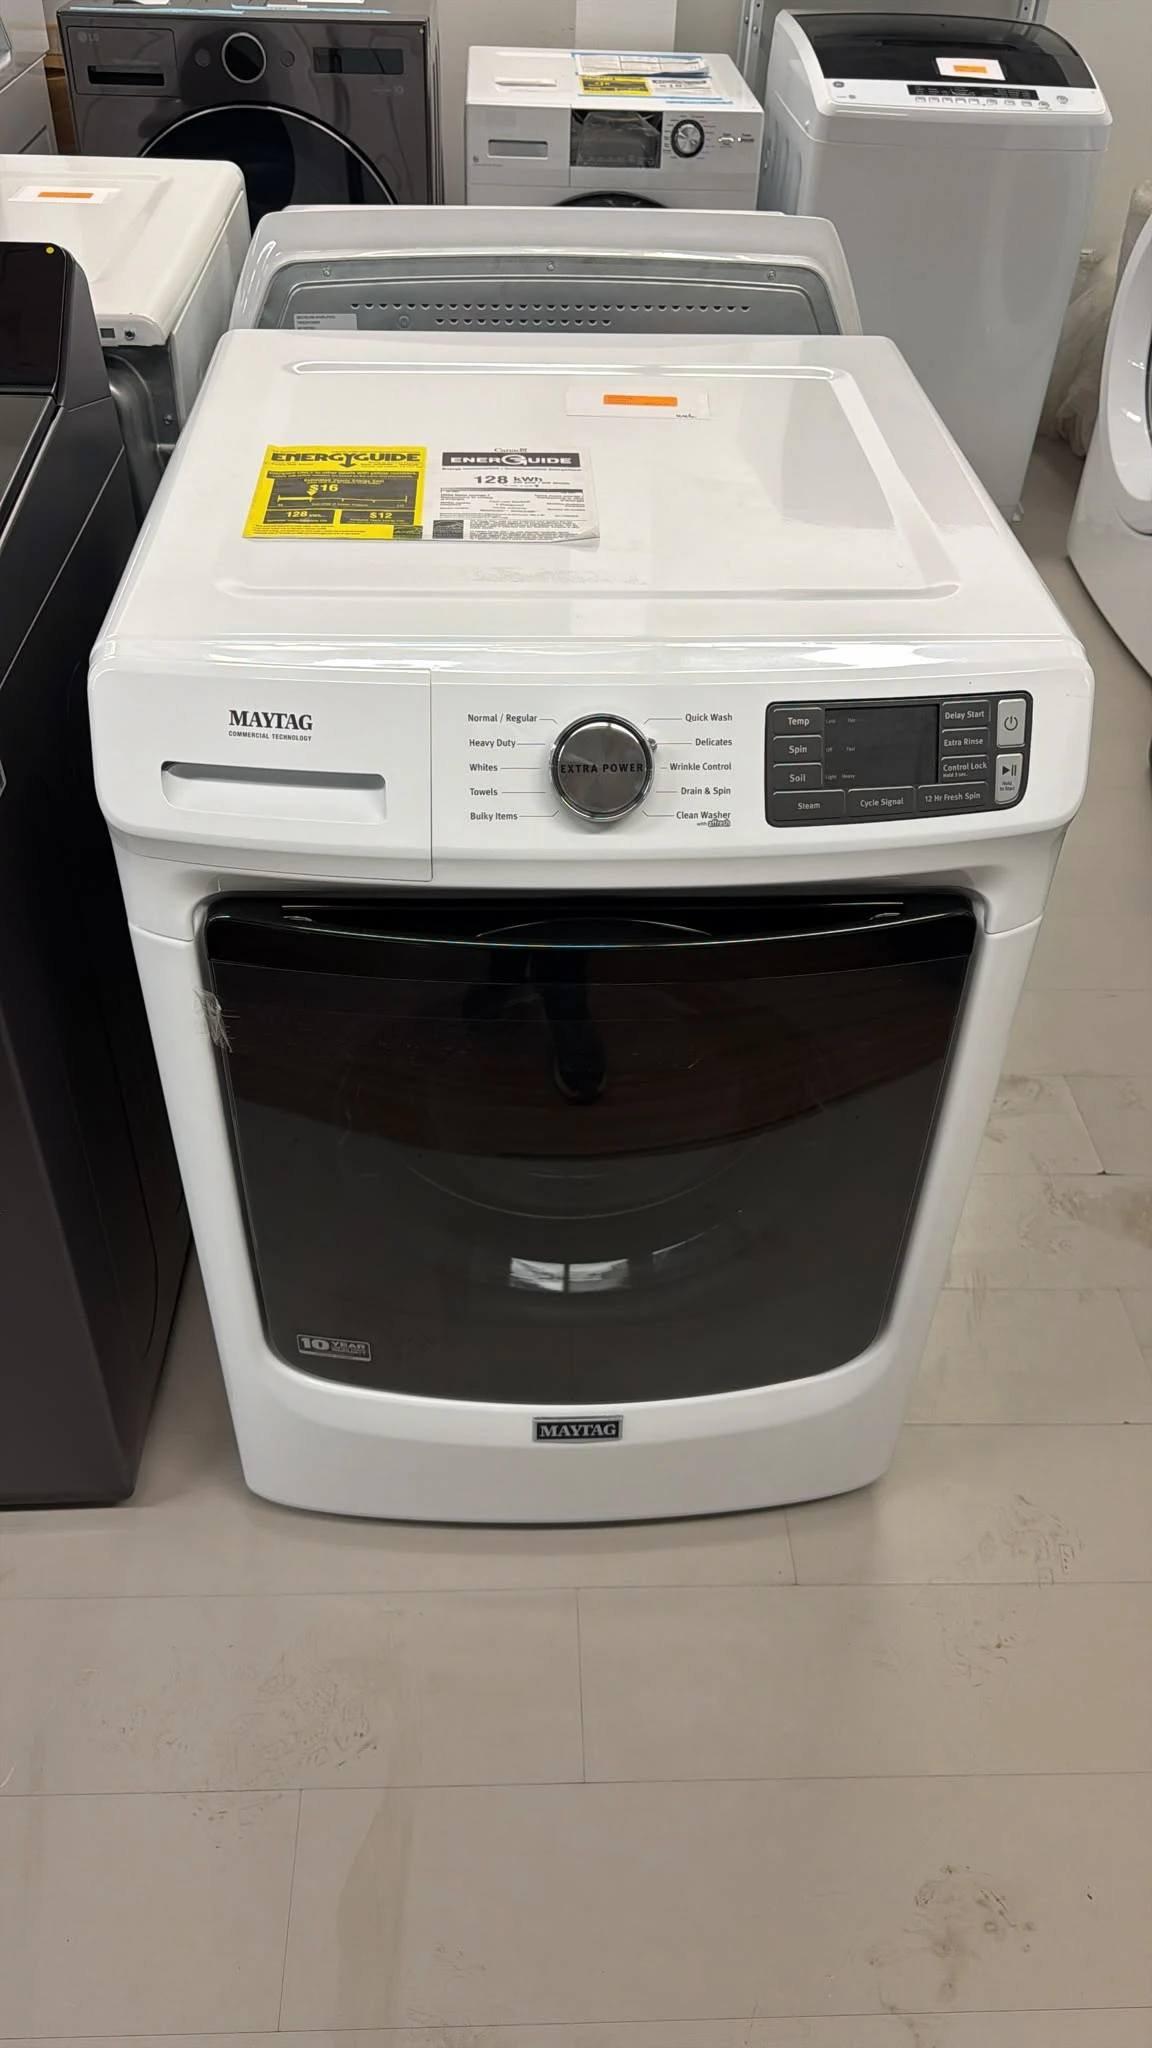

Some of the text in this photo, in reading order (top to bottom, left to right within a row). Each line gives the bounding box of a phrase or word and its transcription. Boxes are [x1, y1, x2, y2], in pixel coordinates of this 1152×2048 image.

[271, 452, 421, 464] ENERGYGUIDE
[450, 454, 572, 466] ENERGUIDE
[474, 475, 543, 484] 128 kWh
[308, 483, 339, 493] $16
[286, 510, 308, 518] 128
[369, 511, 393, 519] $12
[228, 709, 313, 730] MAYTAG
[467, 713, 538, 724] Normal / Regular
[685, 713, 733, 722] Quick Wash
[945, 710, 985, 720] Delay Start
[788, 717, 810, 727] Temp
[228, 730, 312, 742] COMMERCIAL TECHNOLOGY
[469, 739, 517, 749] Heavy Duty
[695, 738, 733, 746] Delicates
[943, 737, 984, 747] Extra Rinse
[789, 745, 808, 756] Spin
[469, 763, 498, 771] Whites
[560, 763, 644, 774] EXTRA POWER
[669, 762, 732, 771] Wrinkle Control
[943, 762, 988, 772] Control Lock
[789, 773, 806, 783] Soil
[470, 788, 498, 796] Towels
[681, 786, 732, 797] Drain & Spin
[925, 791, 981, 803] 12 Hr Fresh Spin
[798, 802, 821, 810] Steam
[860, 797, 904, 808] Cycle Signal
[470, 812, 518, 822] Bulky Items
[676, 811, 731, 819] Clean Washer
[301, 1338, 329, 1350] 10
[539, 1423, 617, 1438] MAYTAG
